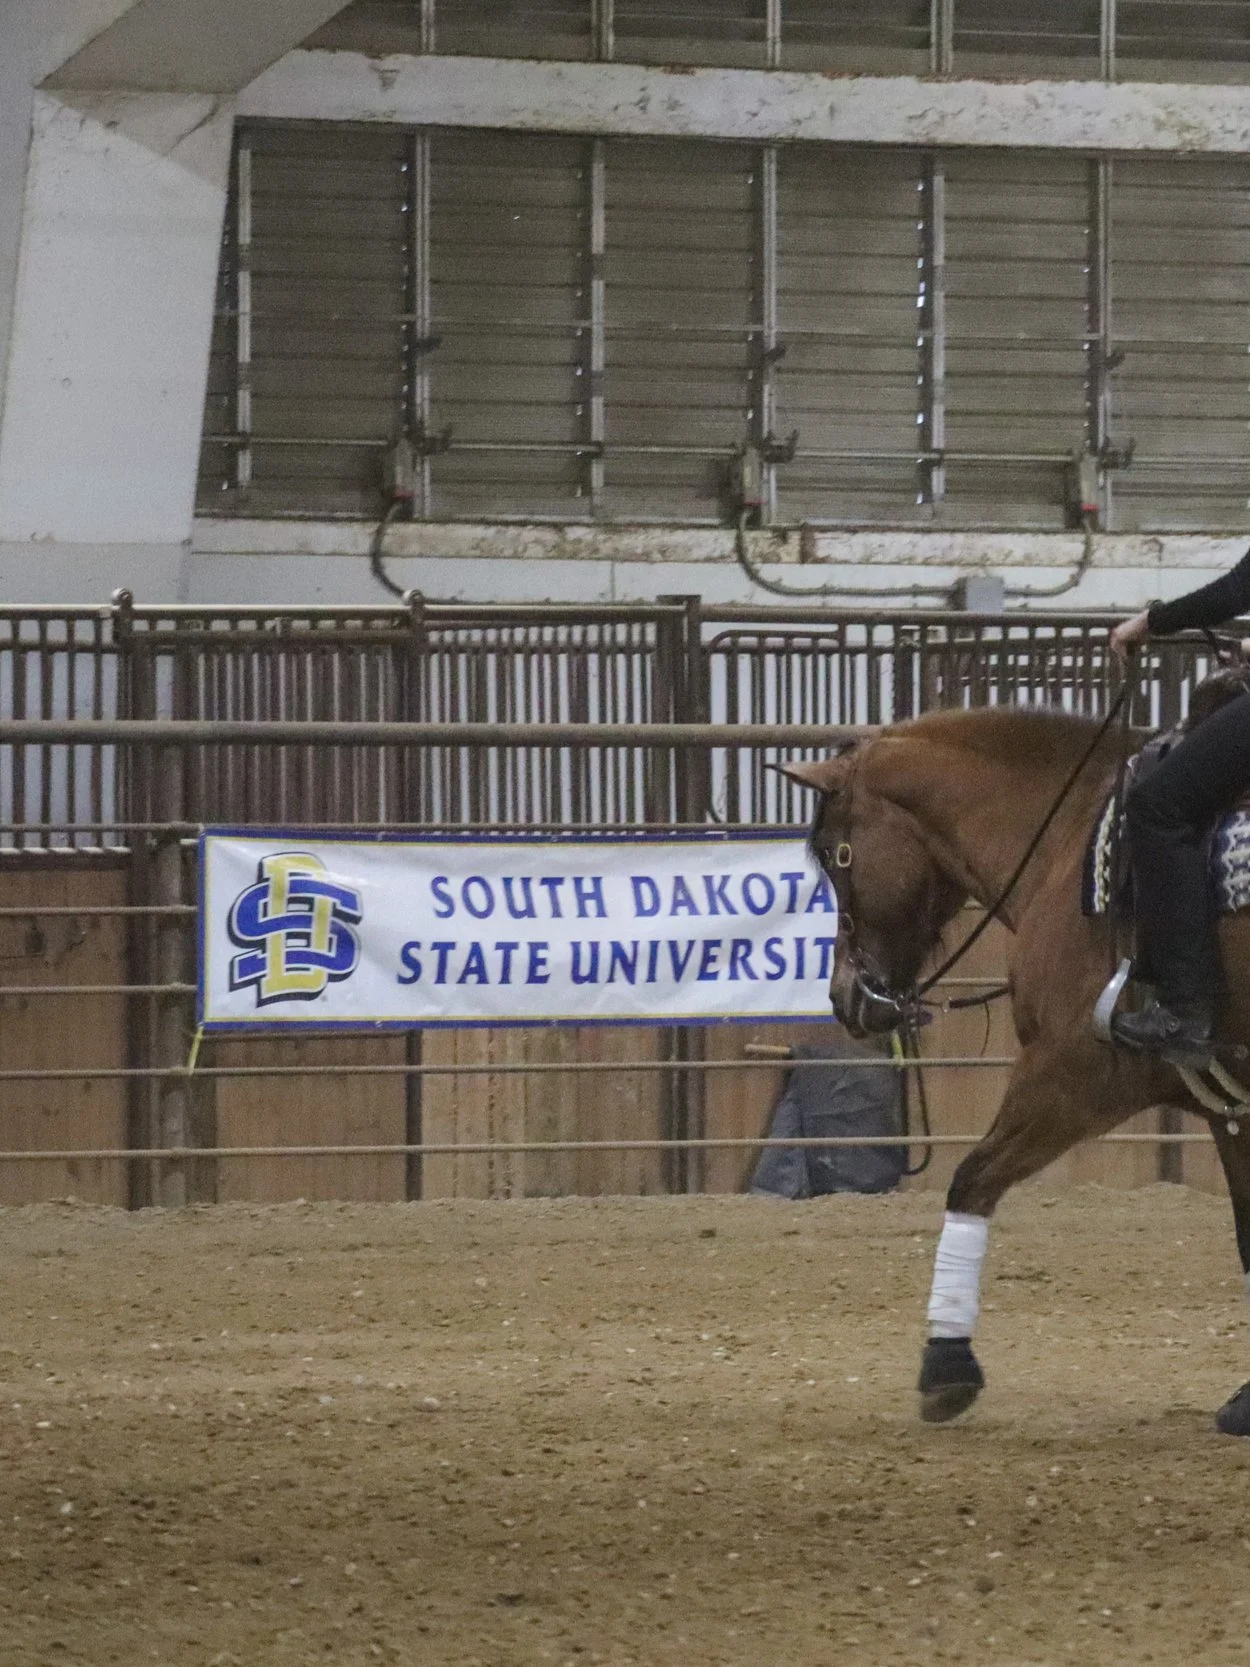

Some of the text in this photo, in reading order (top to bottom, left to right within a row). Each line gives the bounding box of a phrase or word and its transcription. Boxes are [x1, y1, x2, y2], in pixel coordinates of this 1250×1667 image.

[430, 871, 836, 919] SOUTH DAKOTA
[397, 936, 836, 985] STATE UNIVERSIT
